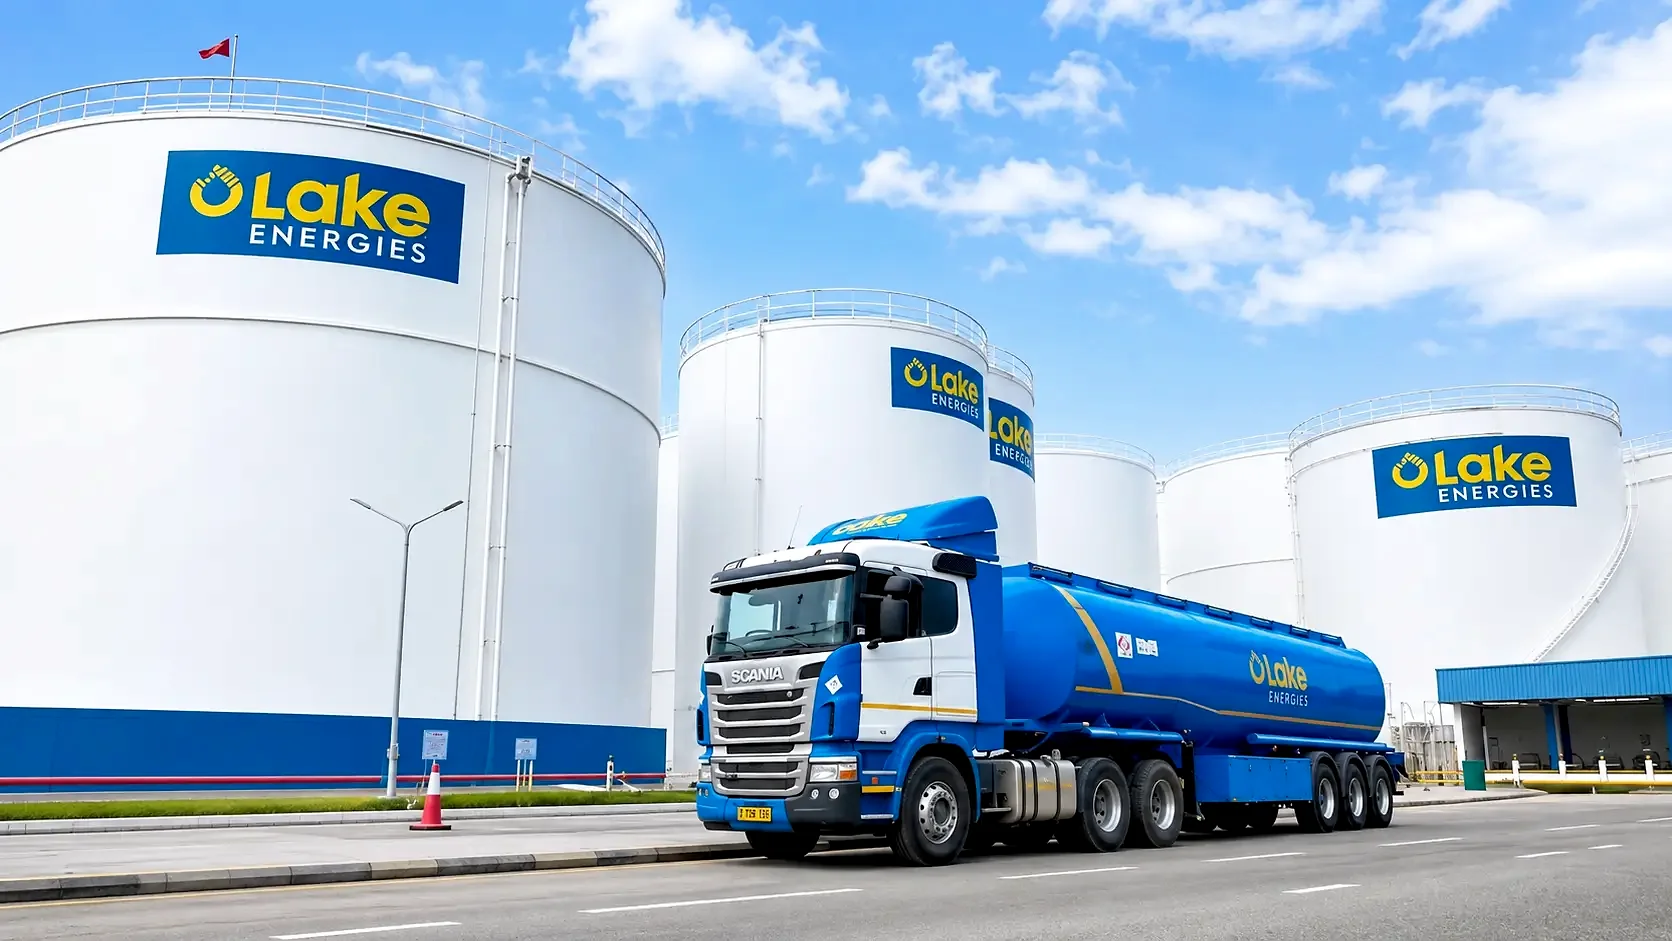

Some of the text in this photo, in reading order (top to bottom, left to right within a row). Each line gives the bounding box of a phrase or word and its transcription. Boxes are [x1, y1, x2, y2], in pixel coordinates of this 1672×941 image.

[251, 171, 431, 238] Lake
[249, 223, 427, 264] ENERGIES
[930, 364, 979, 405] Lake
[931, 392, 979, 419] ENERGIES
[1434, 444, 1552, 485] Lake
[1438, 484, 1554, 503] ENERGIES
[731, 666, 784, 683] SCANIA
[1262, 654, 1308, 691] Lake
[1268, 690, 1308, 707] ENERGIES
